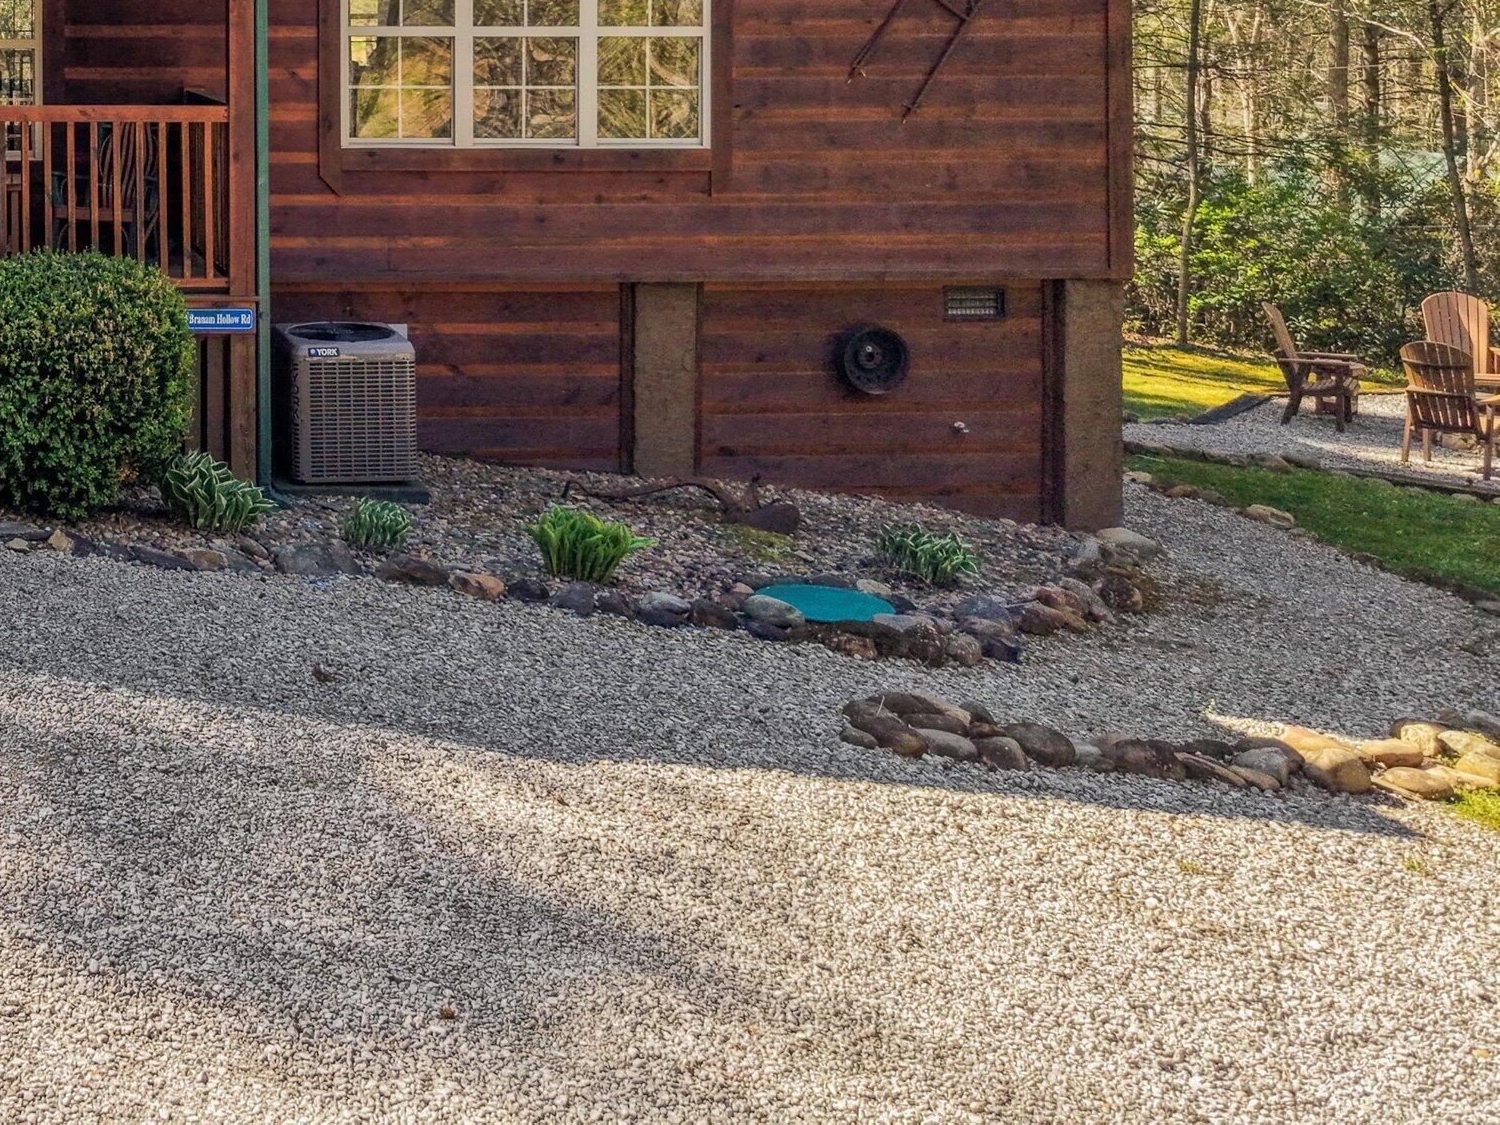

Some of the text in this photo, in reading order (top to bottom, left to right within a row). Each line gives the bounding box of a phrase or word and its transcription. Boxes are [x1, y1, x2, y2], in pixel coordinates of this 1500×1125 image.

[216, 313, 240, 324] Hollow
[241, 313, 251, 324] Rd
[317, 348, 338, 356] YORK
